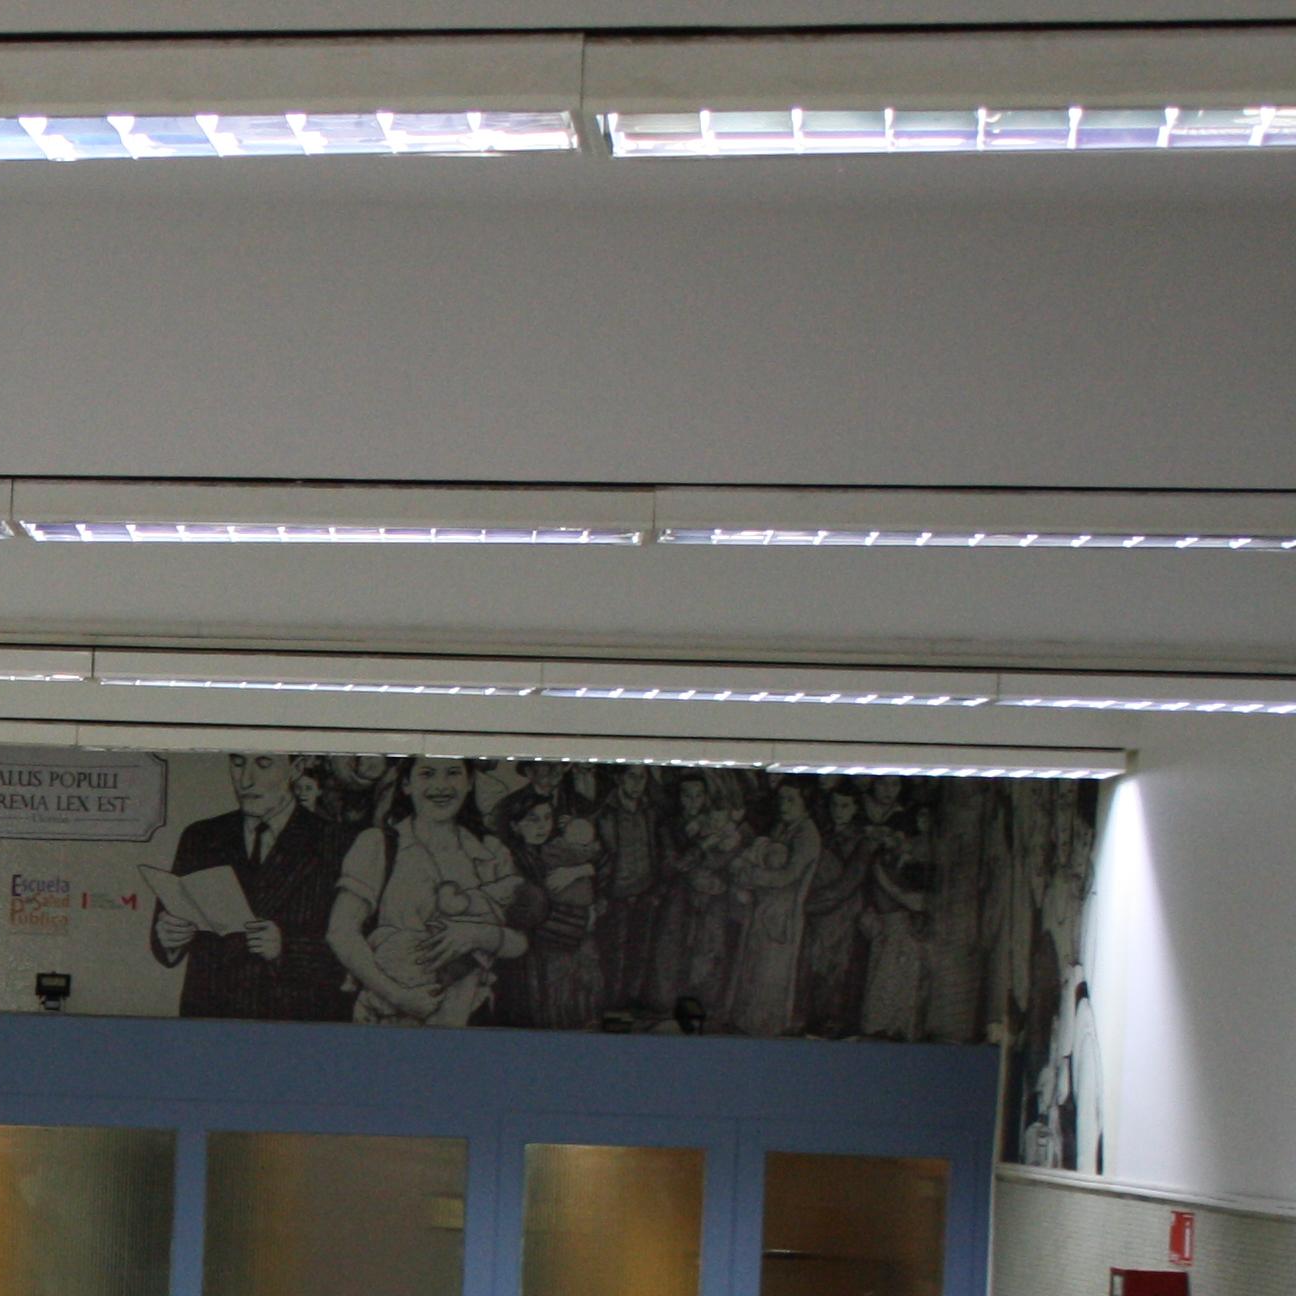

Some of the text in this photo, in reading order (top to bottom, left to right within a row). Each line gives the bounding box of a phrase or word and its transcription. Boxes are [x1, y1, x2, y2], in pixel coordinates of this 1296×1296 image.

[48, 771, 119, 790] POPULI
[56, 795, 90, 812] LEX
[97, 796, 130, 813] EST
[11, 874, 70, 897] Escuela
